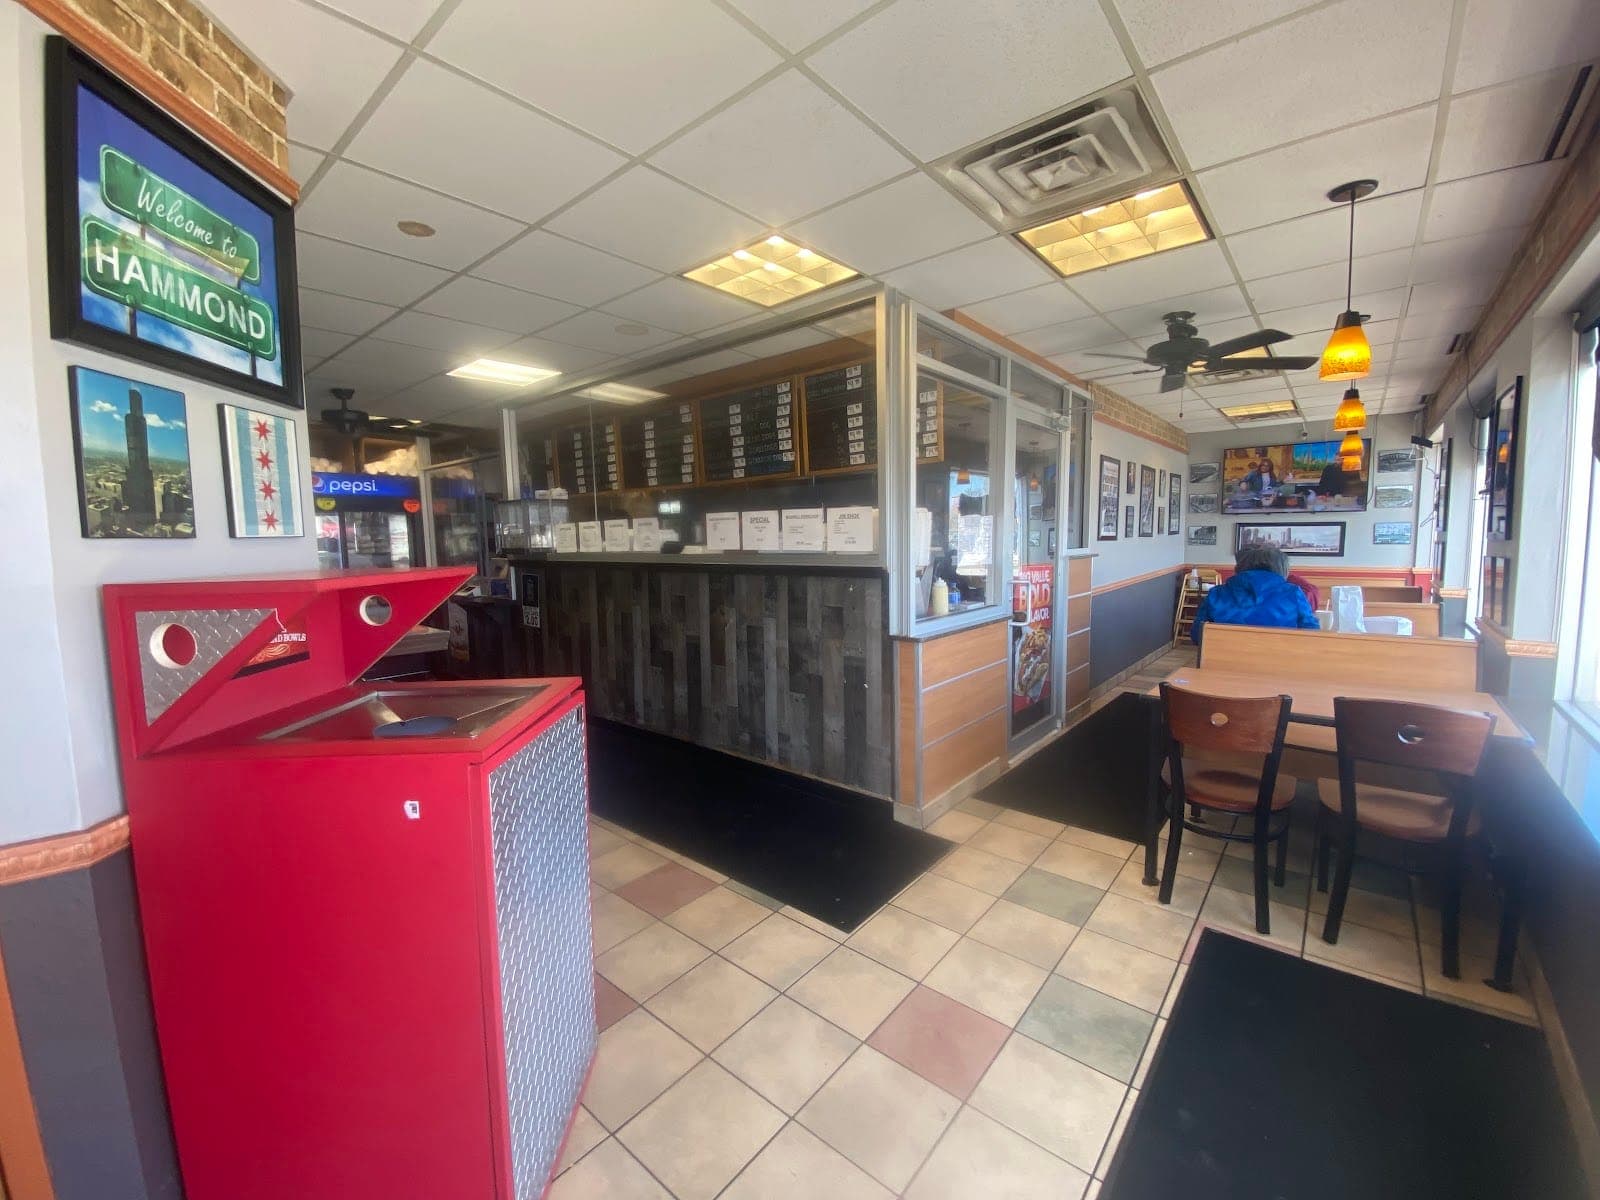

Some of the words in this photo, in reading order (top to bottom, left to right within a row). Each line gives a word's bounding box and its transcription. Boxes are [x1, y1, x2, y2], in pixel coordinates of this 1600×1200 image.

[138, 177, 213, 246] Welcome
[222, 236, 238, 259] to
[95, 239, 266, 340] HAMMOND
[329, 479, 376, 494] pepsi
[1019, 583, 1051, 610] BOLD
[1030, 607, 1050, 623] LAVOR.
[283, 632, 307, 642] BOWLS
